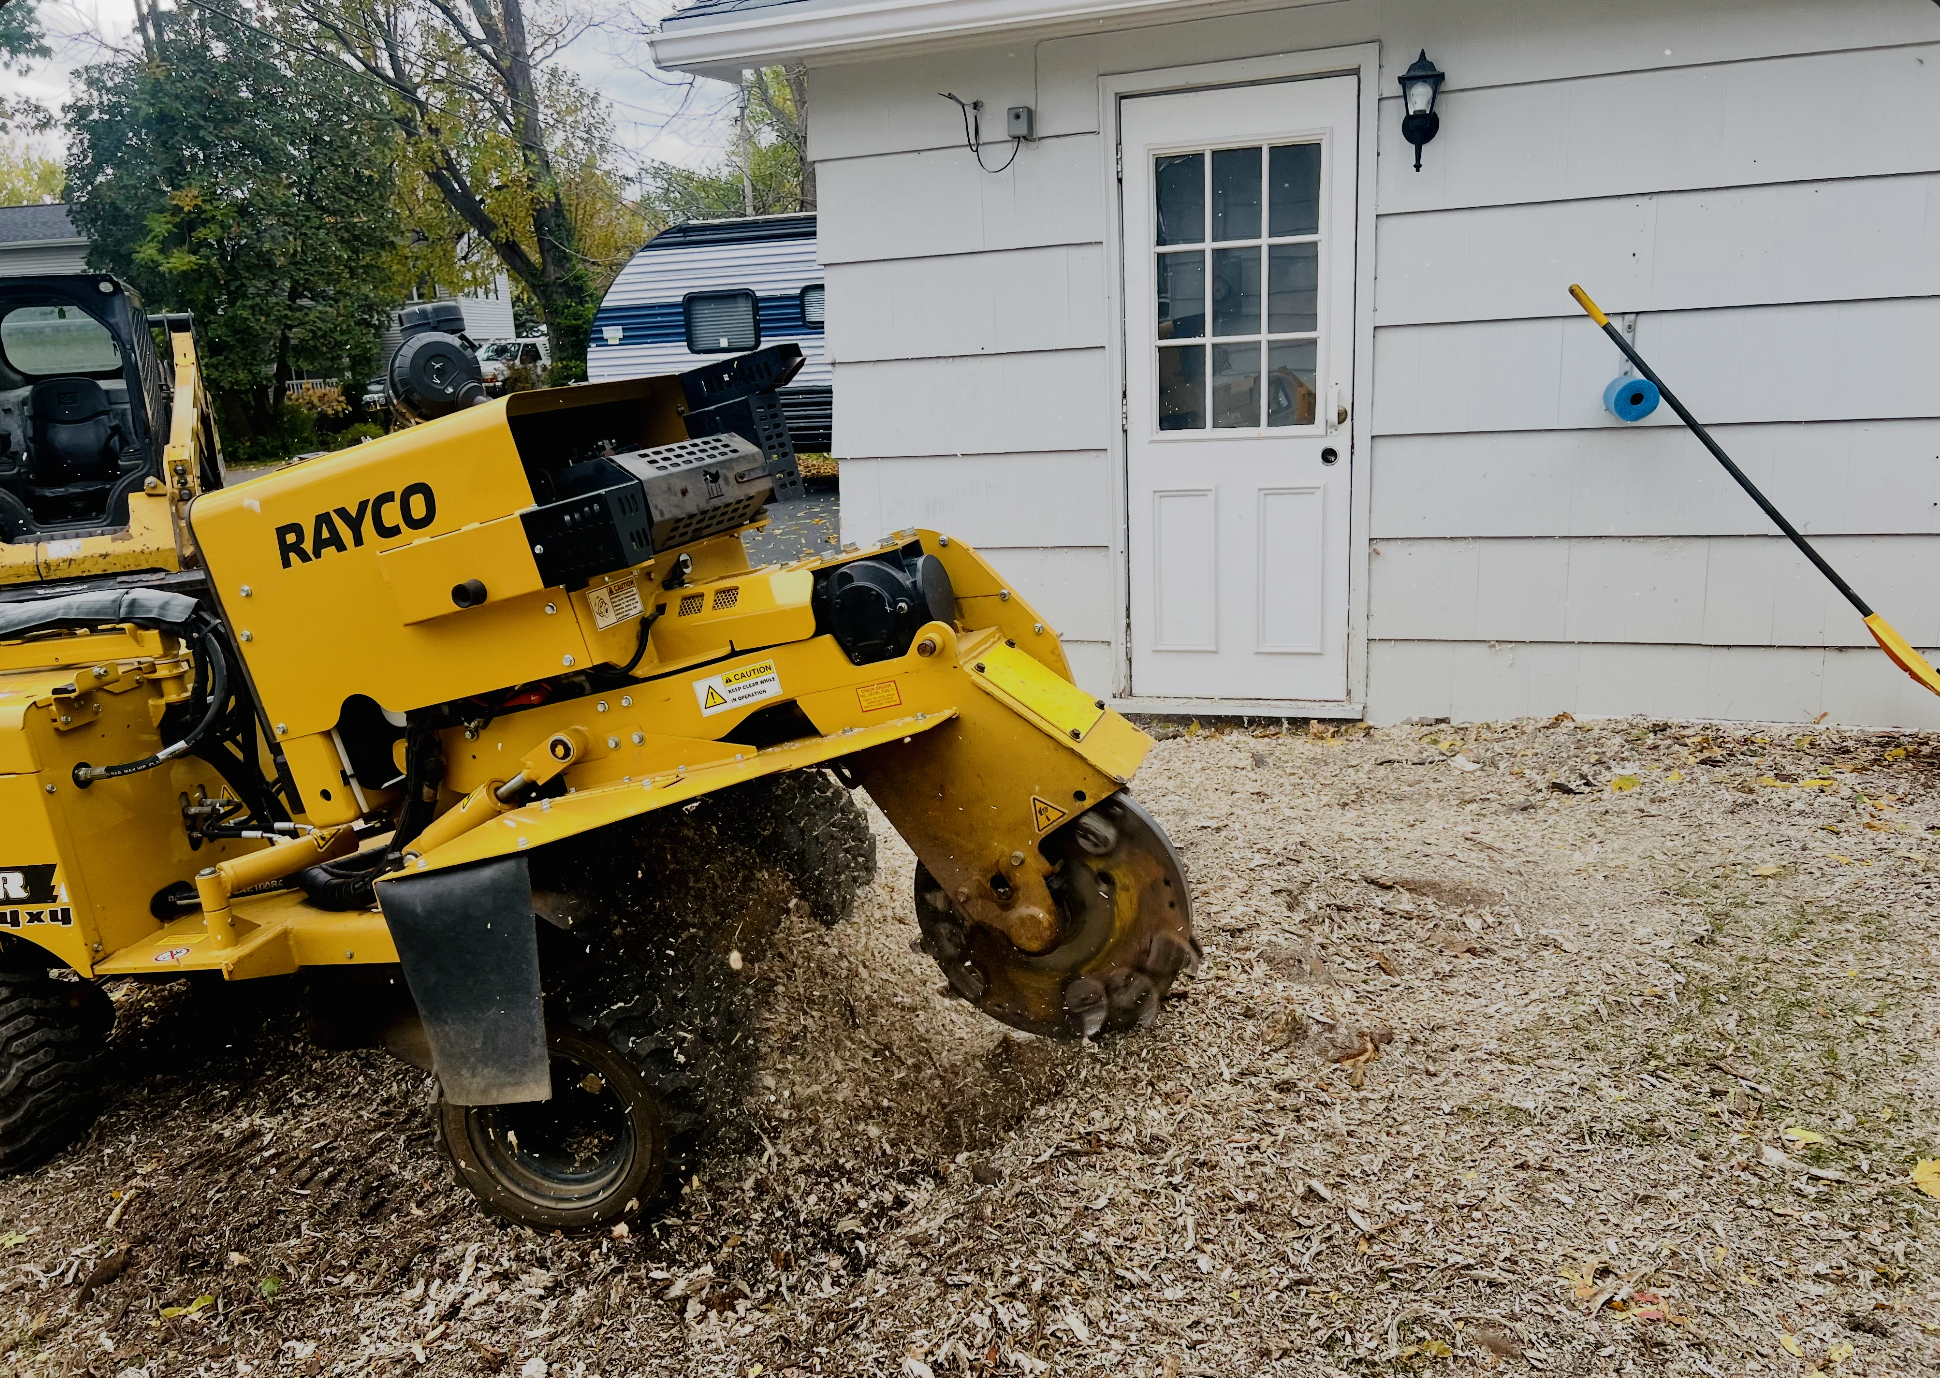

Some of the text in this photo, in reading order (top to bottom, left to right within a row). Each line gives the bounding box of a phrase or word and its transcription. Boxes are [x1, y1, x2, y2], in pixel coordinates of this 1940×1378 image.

[275, 482, 437, 570] RAYCO
[733, 664, 772, 681] CAUTION
[727, 676, 776, 695] KEEP CLEAR WHILE
[737, 689, 767, 702] OPERATION
